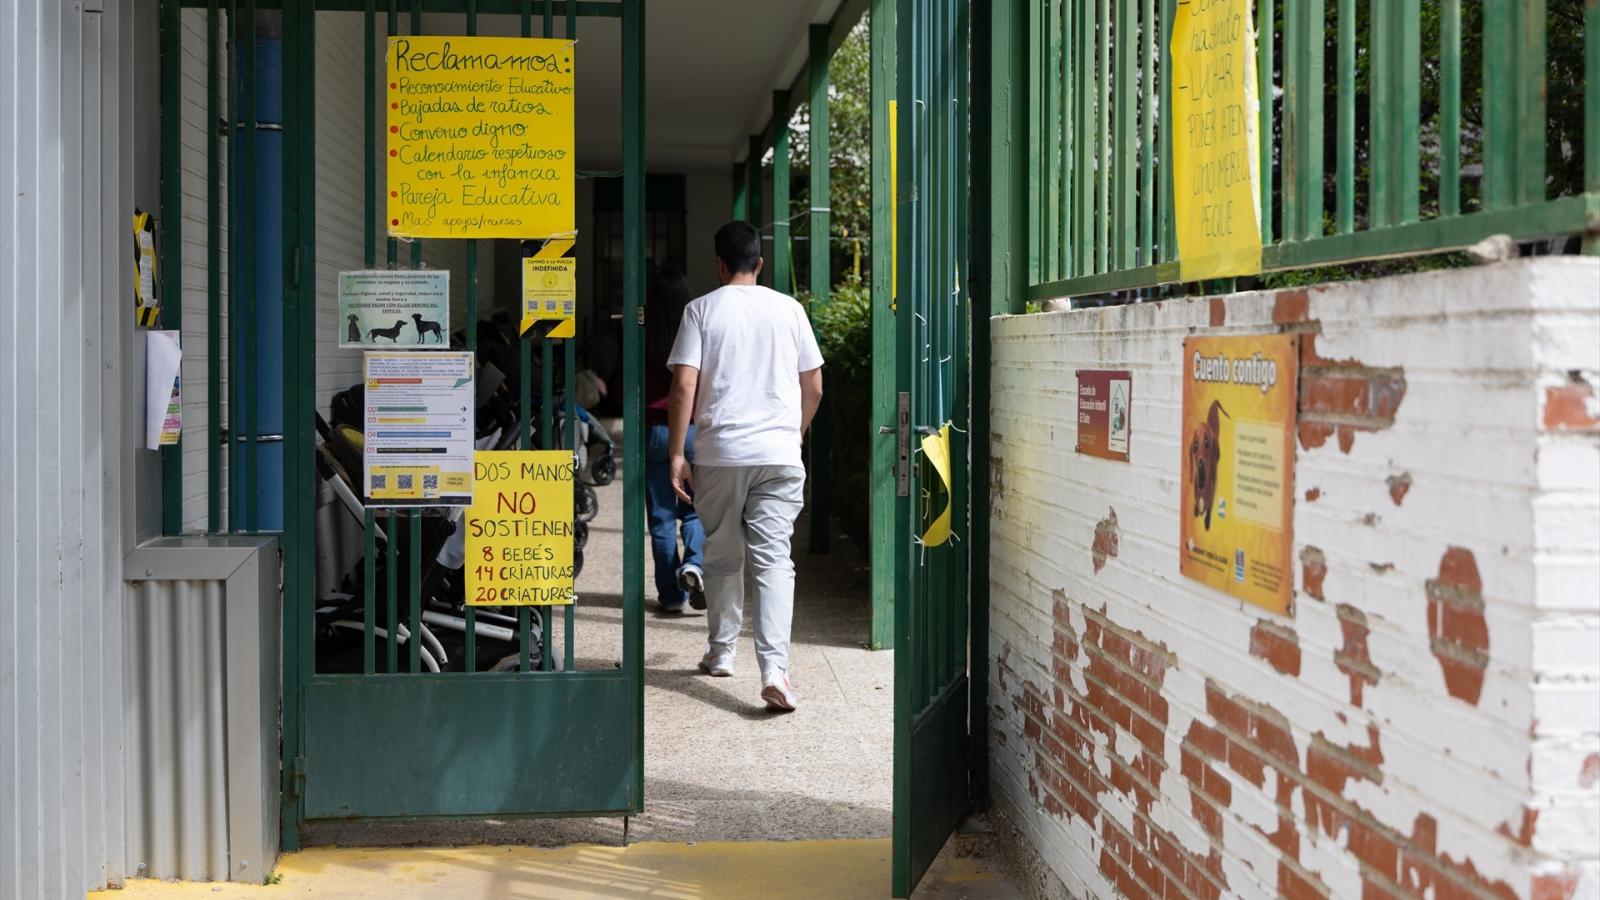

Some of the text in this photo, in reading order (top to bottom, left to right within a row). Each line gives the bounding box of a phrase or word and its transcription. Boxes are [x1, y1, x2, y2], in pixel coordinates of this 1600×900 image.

[396, 39, 572, 74] Reclamamos:
[400, 77, 572, 95] Reconocimiento Educativo
[400, 96, 552, 122] Bajadas de ratios
[472, 120, 528, 148] digno
[400, 142, 567, 166] Calendario respetuoso
[416, 163, 561, 188] con la infancia
[400, 182, 560, 219] Pareja Educativa
[1194, 350, 1276, 394] Cuento contigo
[474, 462, 510, 482] DOS
[521, 462, 574, 482] MANOS
[497, 492, 536, 515] NO
[470, 517, 573, 538] SOSTIENEN
[482, 544, 554, 562] 8 BEBÉS
[475, 564, 574, 581] 14 CRIATURAS
[476, 586, 573, 602] 20 CRIATURAS
